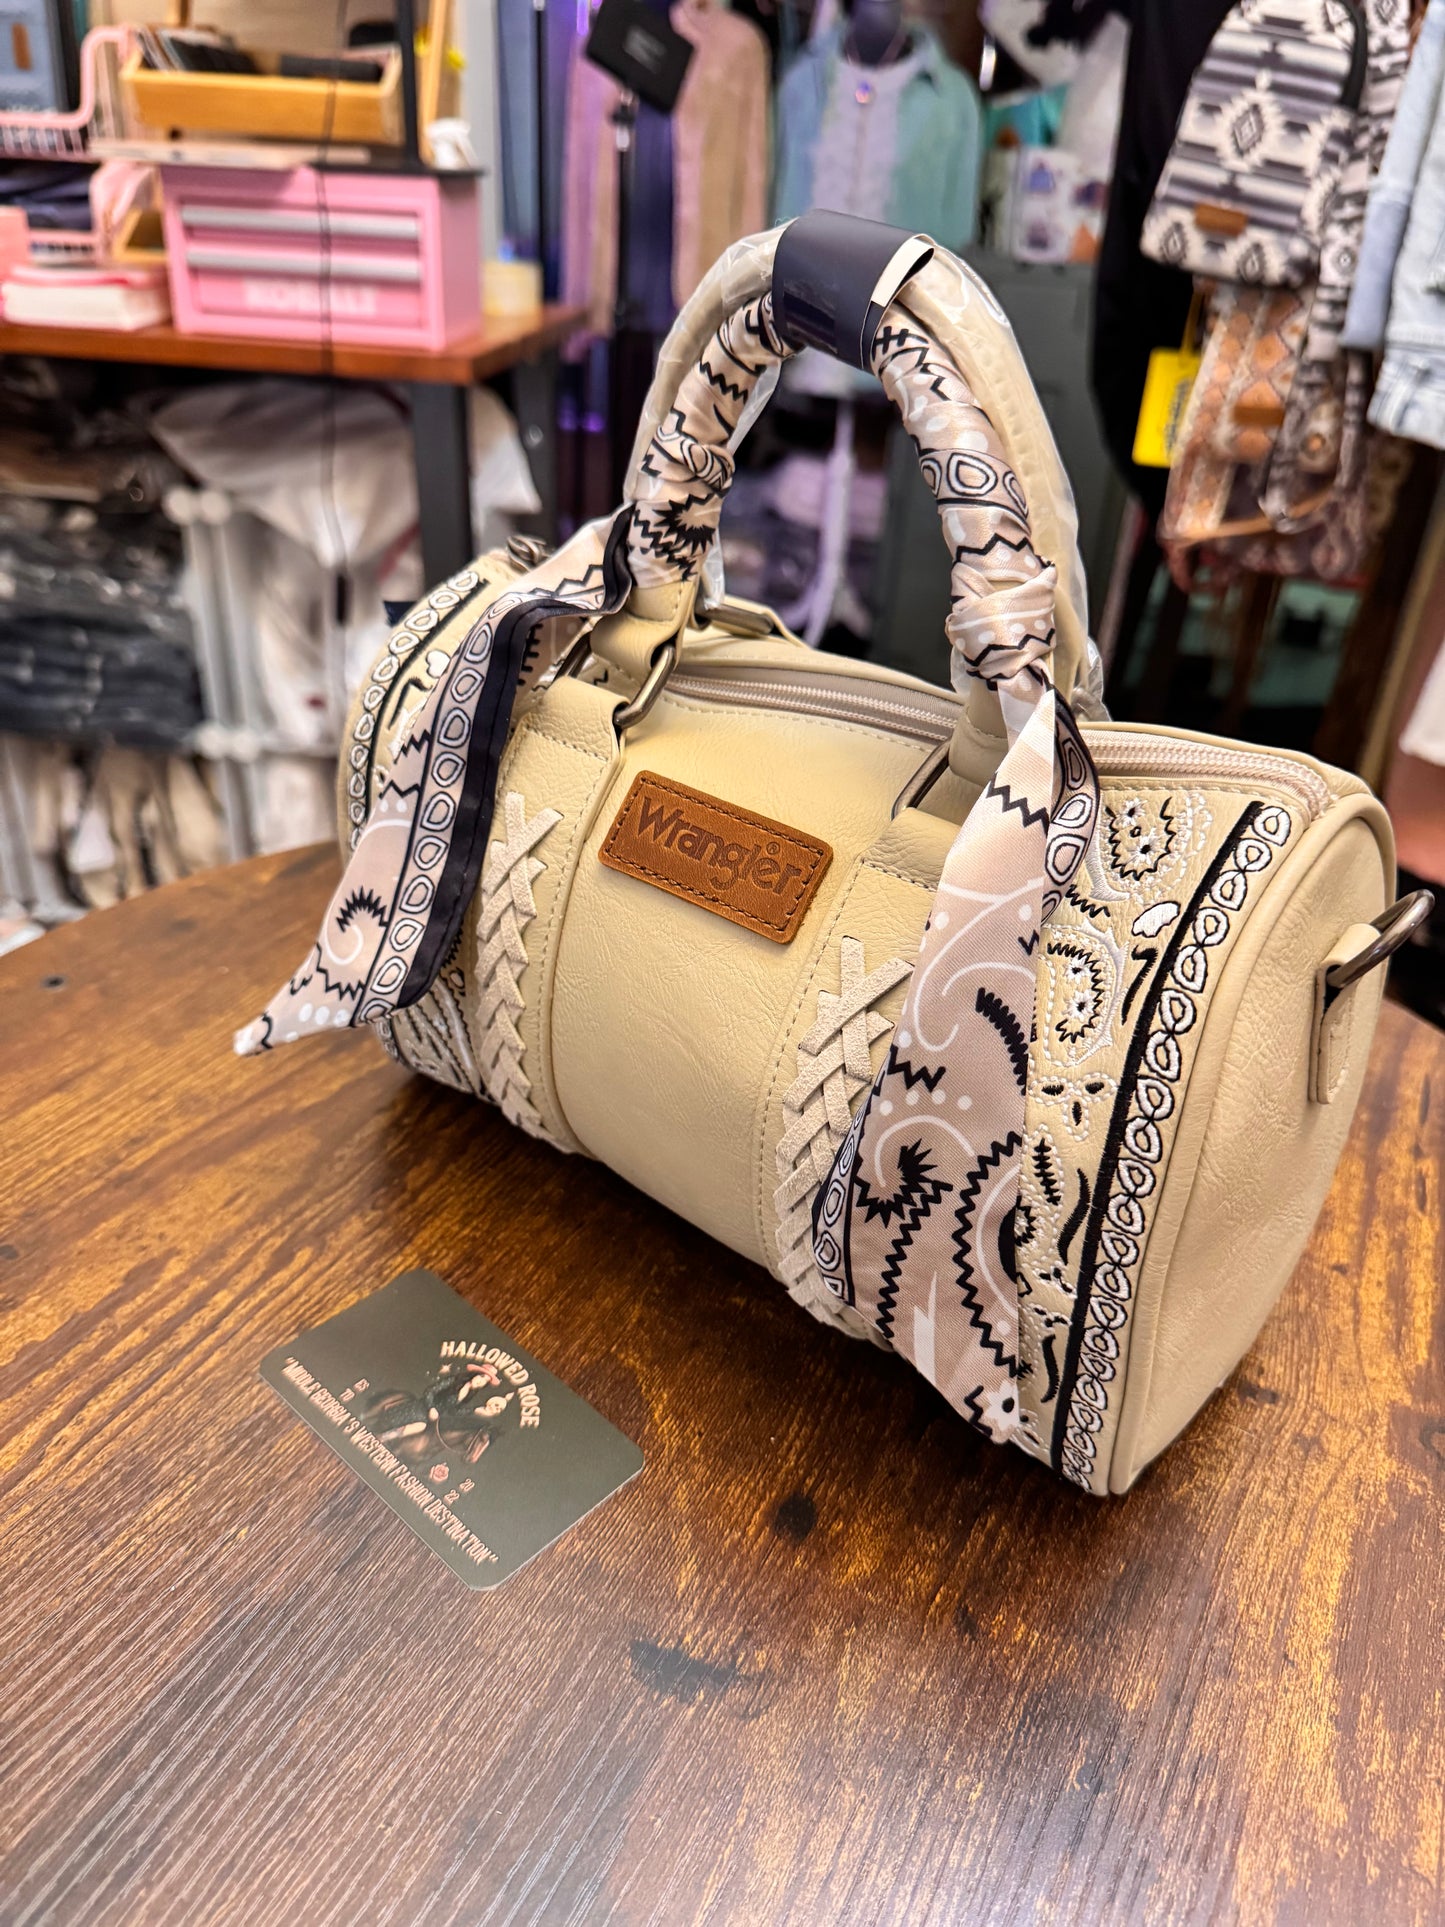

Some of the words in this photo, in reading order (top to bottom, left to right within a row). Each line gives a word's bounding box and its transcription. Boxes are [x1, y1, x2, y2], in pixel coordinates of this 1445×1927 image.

[637, 796, 802, 895] Wrangler
[440, 1341, 529, 1385] HALLOWED
[517, 1383, 541, 1428] ROSE
[350, 1425, 400, 1474] WESTERN
[387, 1463, 435, 1509] FASHION
[444, 1489, 460, 1505] 22
[459, 1478, 475, 1492] 20
